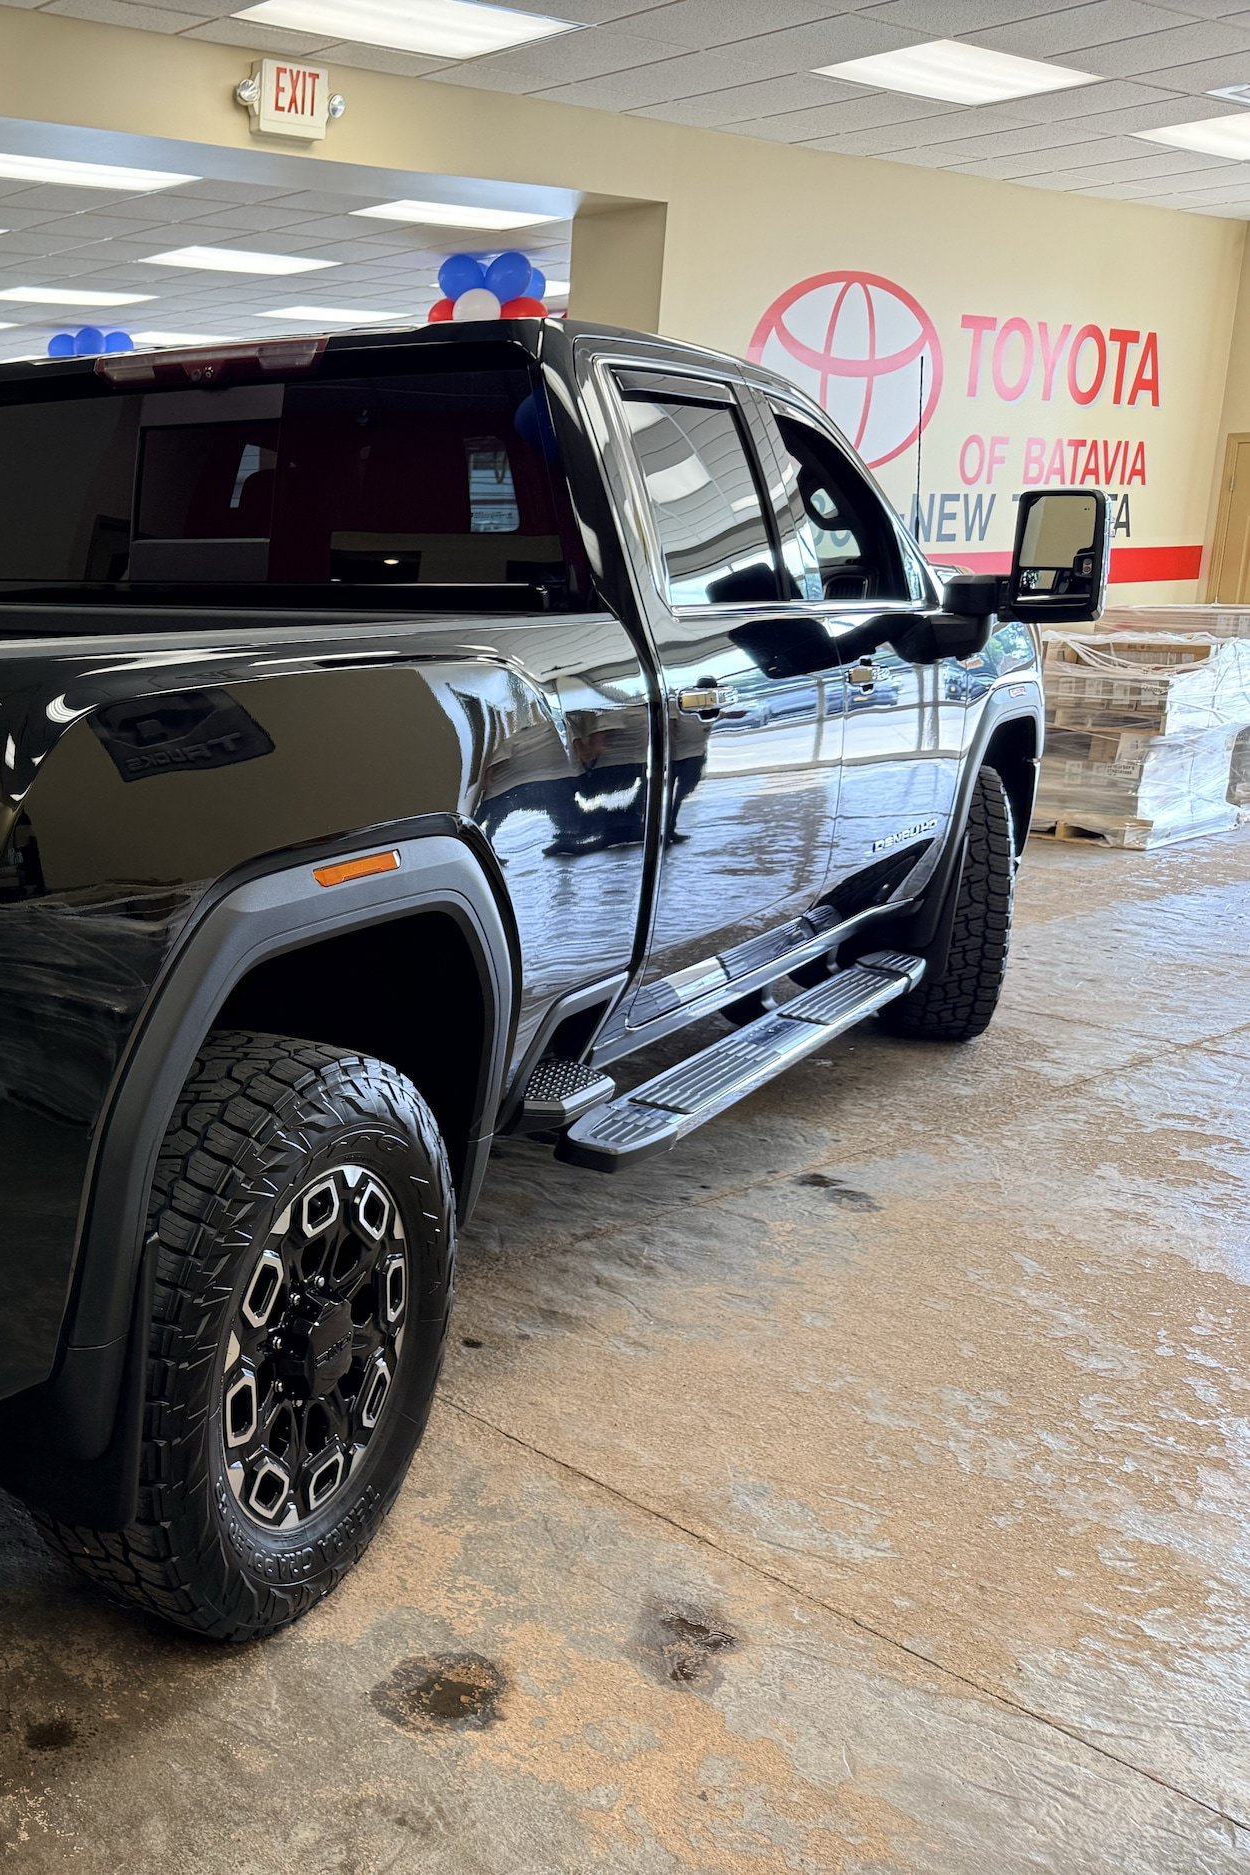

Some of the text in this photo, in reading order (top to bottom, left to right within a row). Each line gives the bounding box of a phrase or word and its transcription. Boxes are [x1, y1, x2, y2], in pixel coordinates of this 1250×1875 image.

[274, 66, 320, 117] EXIT
[960, 314, 1160, 407] TOYOTA
[958, 434, 1146, 486] OF BATAVIA
